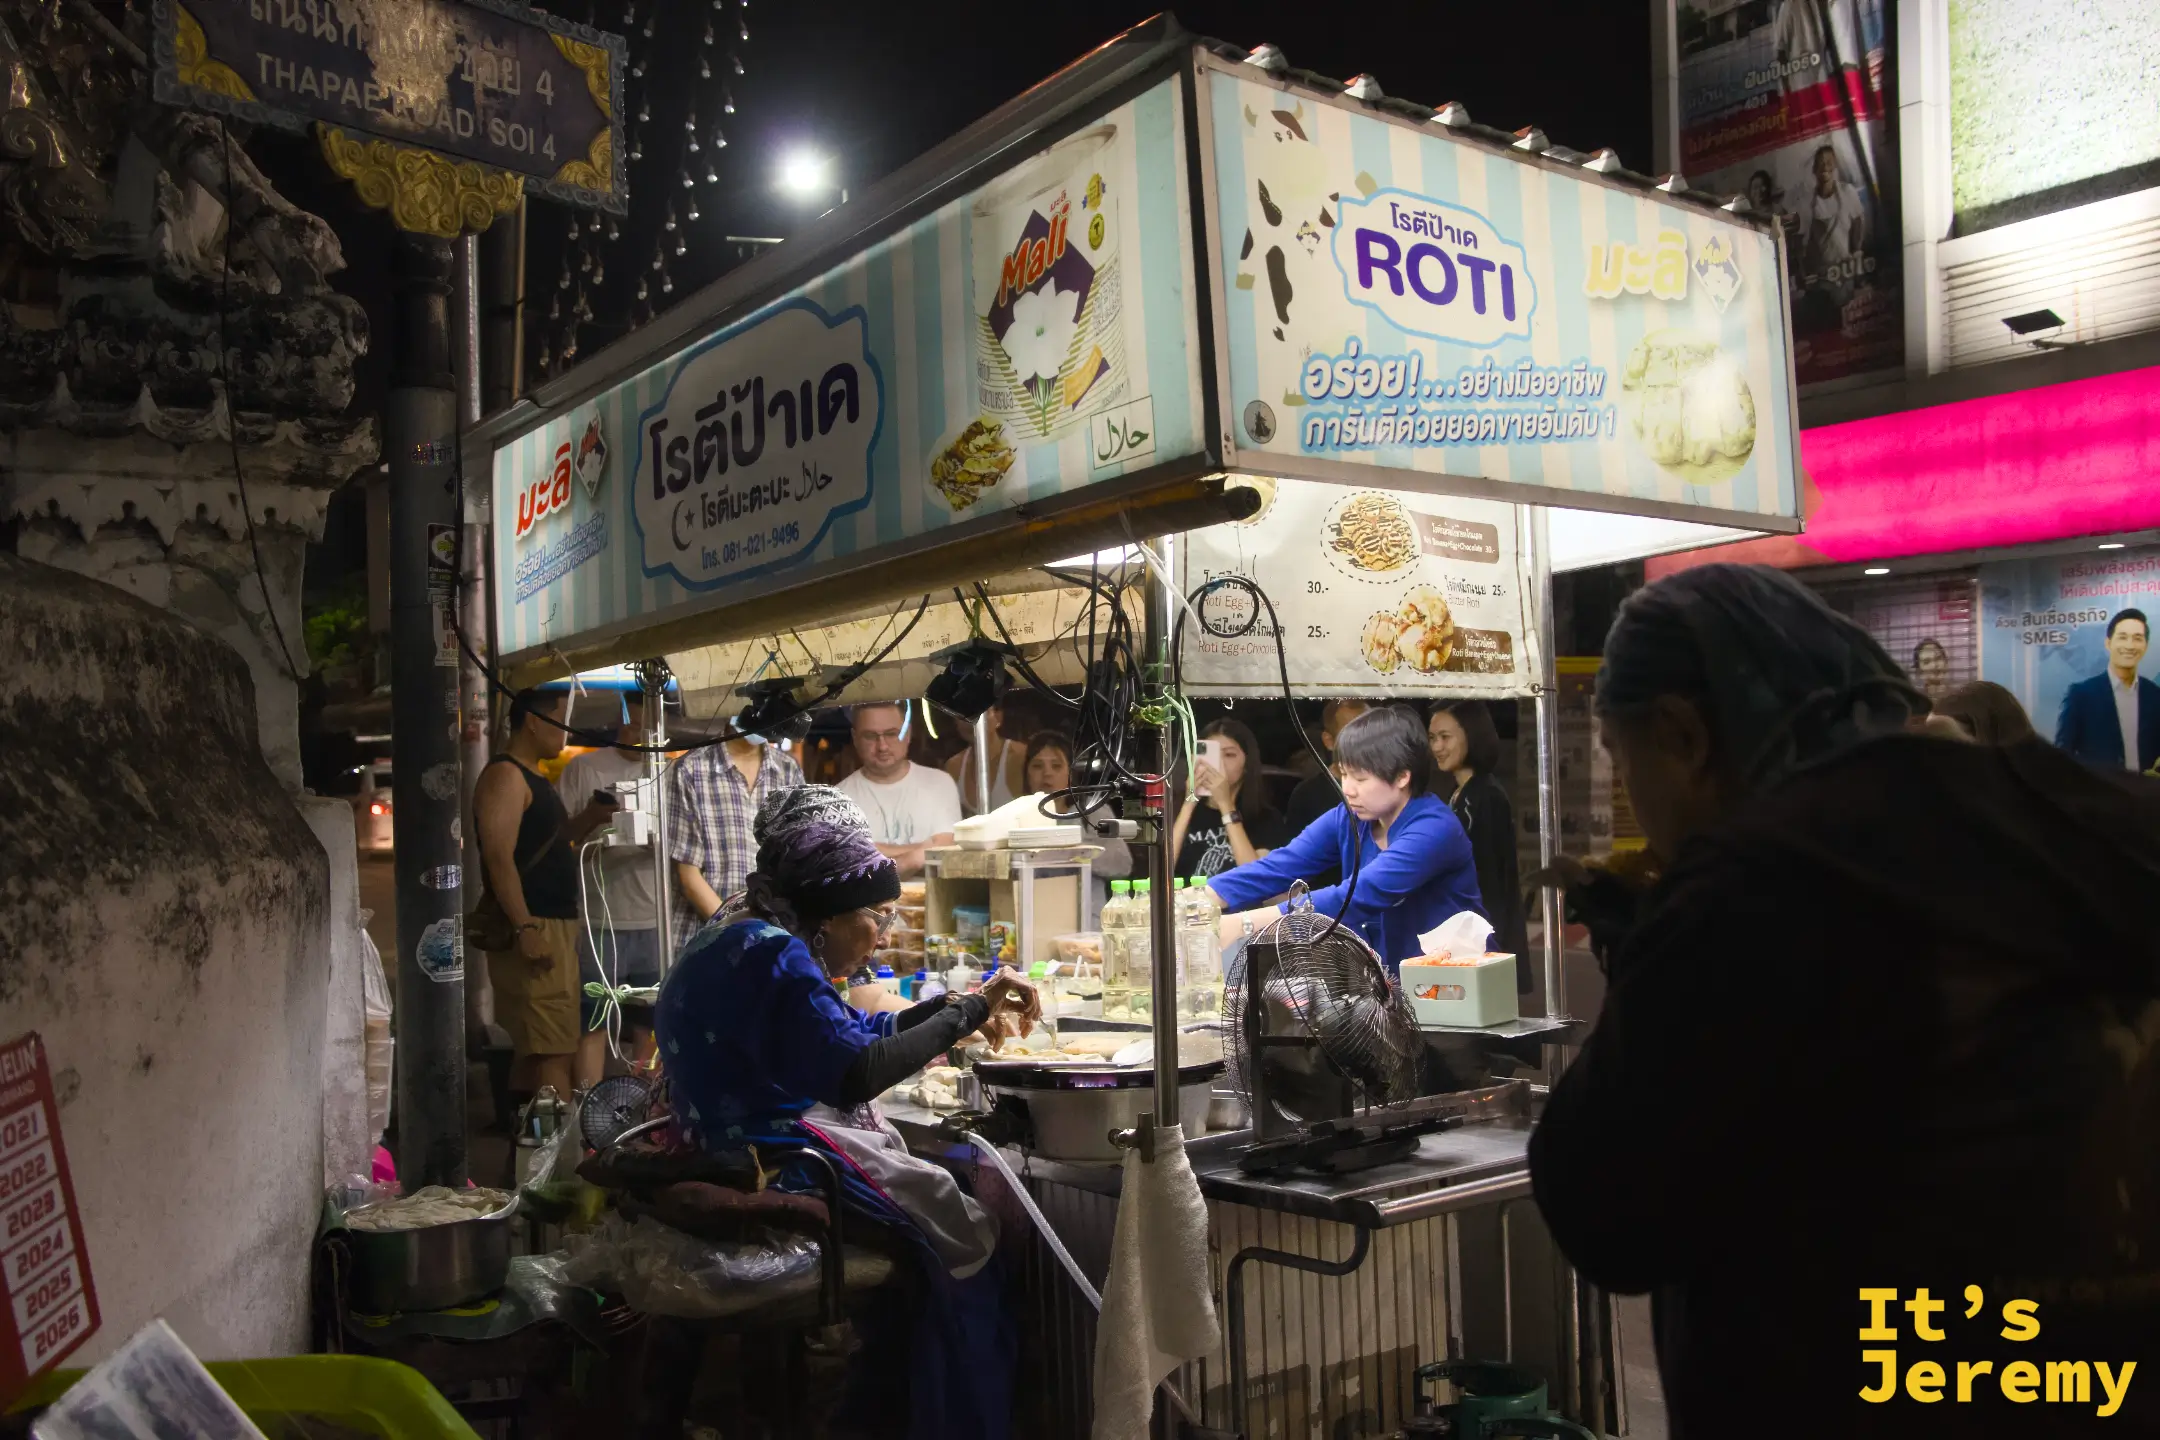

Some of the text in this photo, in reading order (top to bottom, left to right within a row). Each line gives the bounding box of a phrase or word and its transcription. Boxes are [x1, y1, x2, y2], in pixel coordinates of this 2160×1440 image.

[256, 52, 557, 161] THAPAE ROAD SOI 4
[536, 69, 555, 106] 4
[1390, 202, 1478, 250] โรตีป้าเด
[999, 201, 1073, 308] Mali
[1354, 228, 1516, 322] ROTI
[1588, 232, 1688, 294] มะลิ
[649, 362, 860, 500] โรตีป้าเด
[516, 441, 571, 537] มะลิ
[723, 520, 800, 564] 081-021-9496
[1307, 581, 1329, 594] 30.-
[1198, 640, 1287, 657] Roti Egg+Chocolae
[1307, 625, 1331, 639] 25.-
[2021, 630, 2069, 646] SMEs
[0, 1109, 38, 1154] 021
[7, 1187, 56, 1239] 2023
[16, 1227, 65, 1280] 2024
[26, 1266, 72, 1320] 2025
[35, 1303, 80, 1360] 2026
